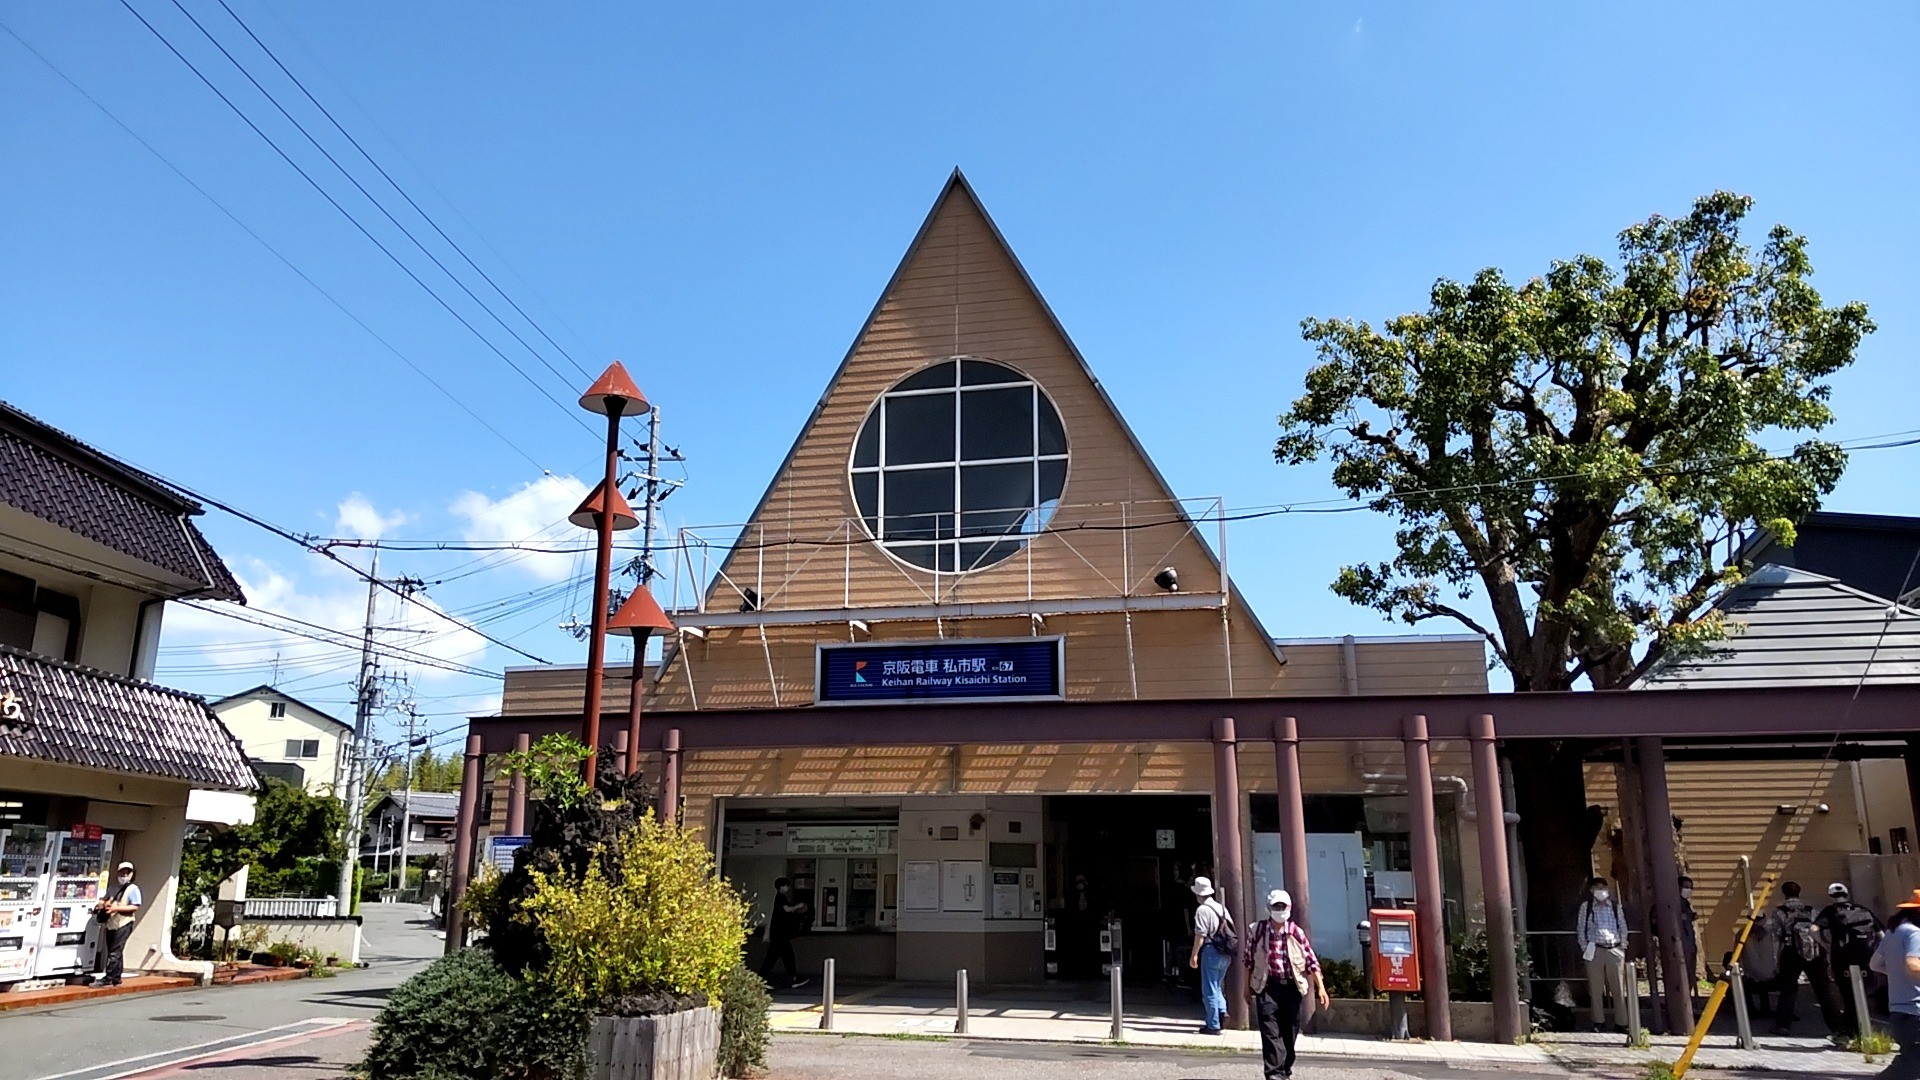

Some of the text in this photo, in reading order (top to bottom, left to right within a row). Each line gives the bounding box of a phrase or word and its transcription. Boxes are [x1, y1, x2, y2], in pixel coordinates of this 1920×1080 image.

[882, 658, 986, 675] 京阪電車 私市駅
[1000, 661, 1012, 671] 67
[882, 674, 1027, 687] Keihan Railway Kisaichi Station
